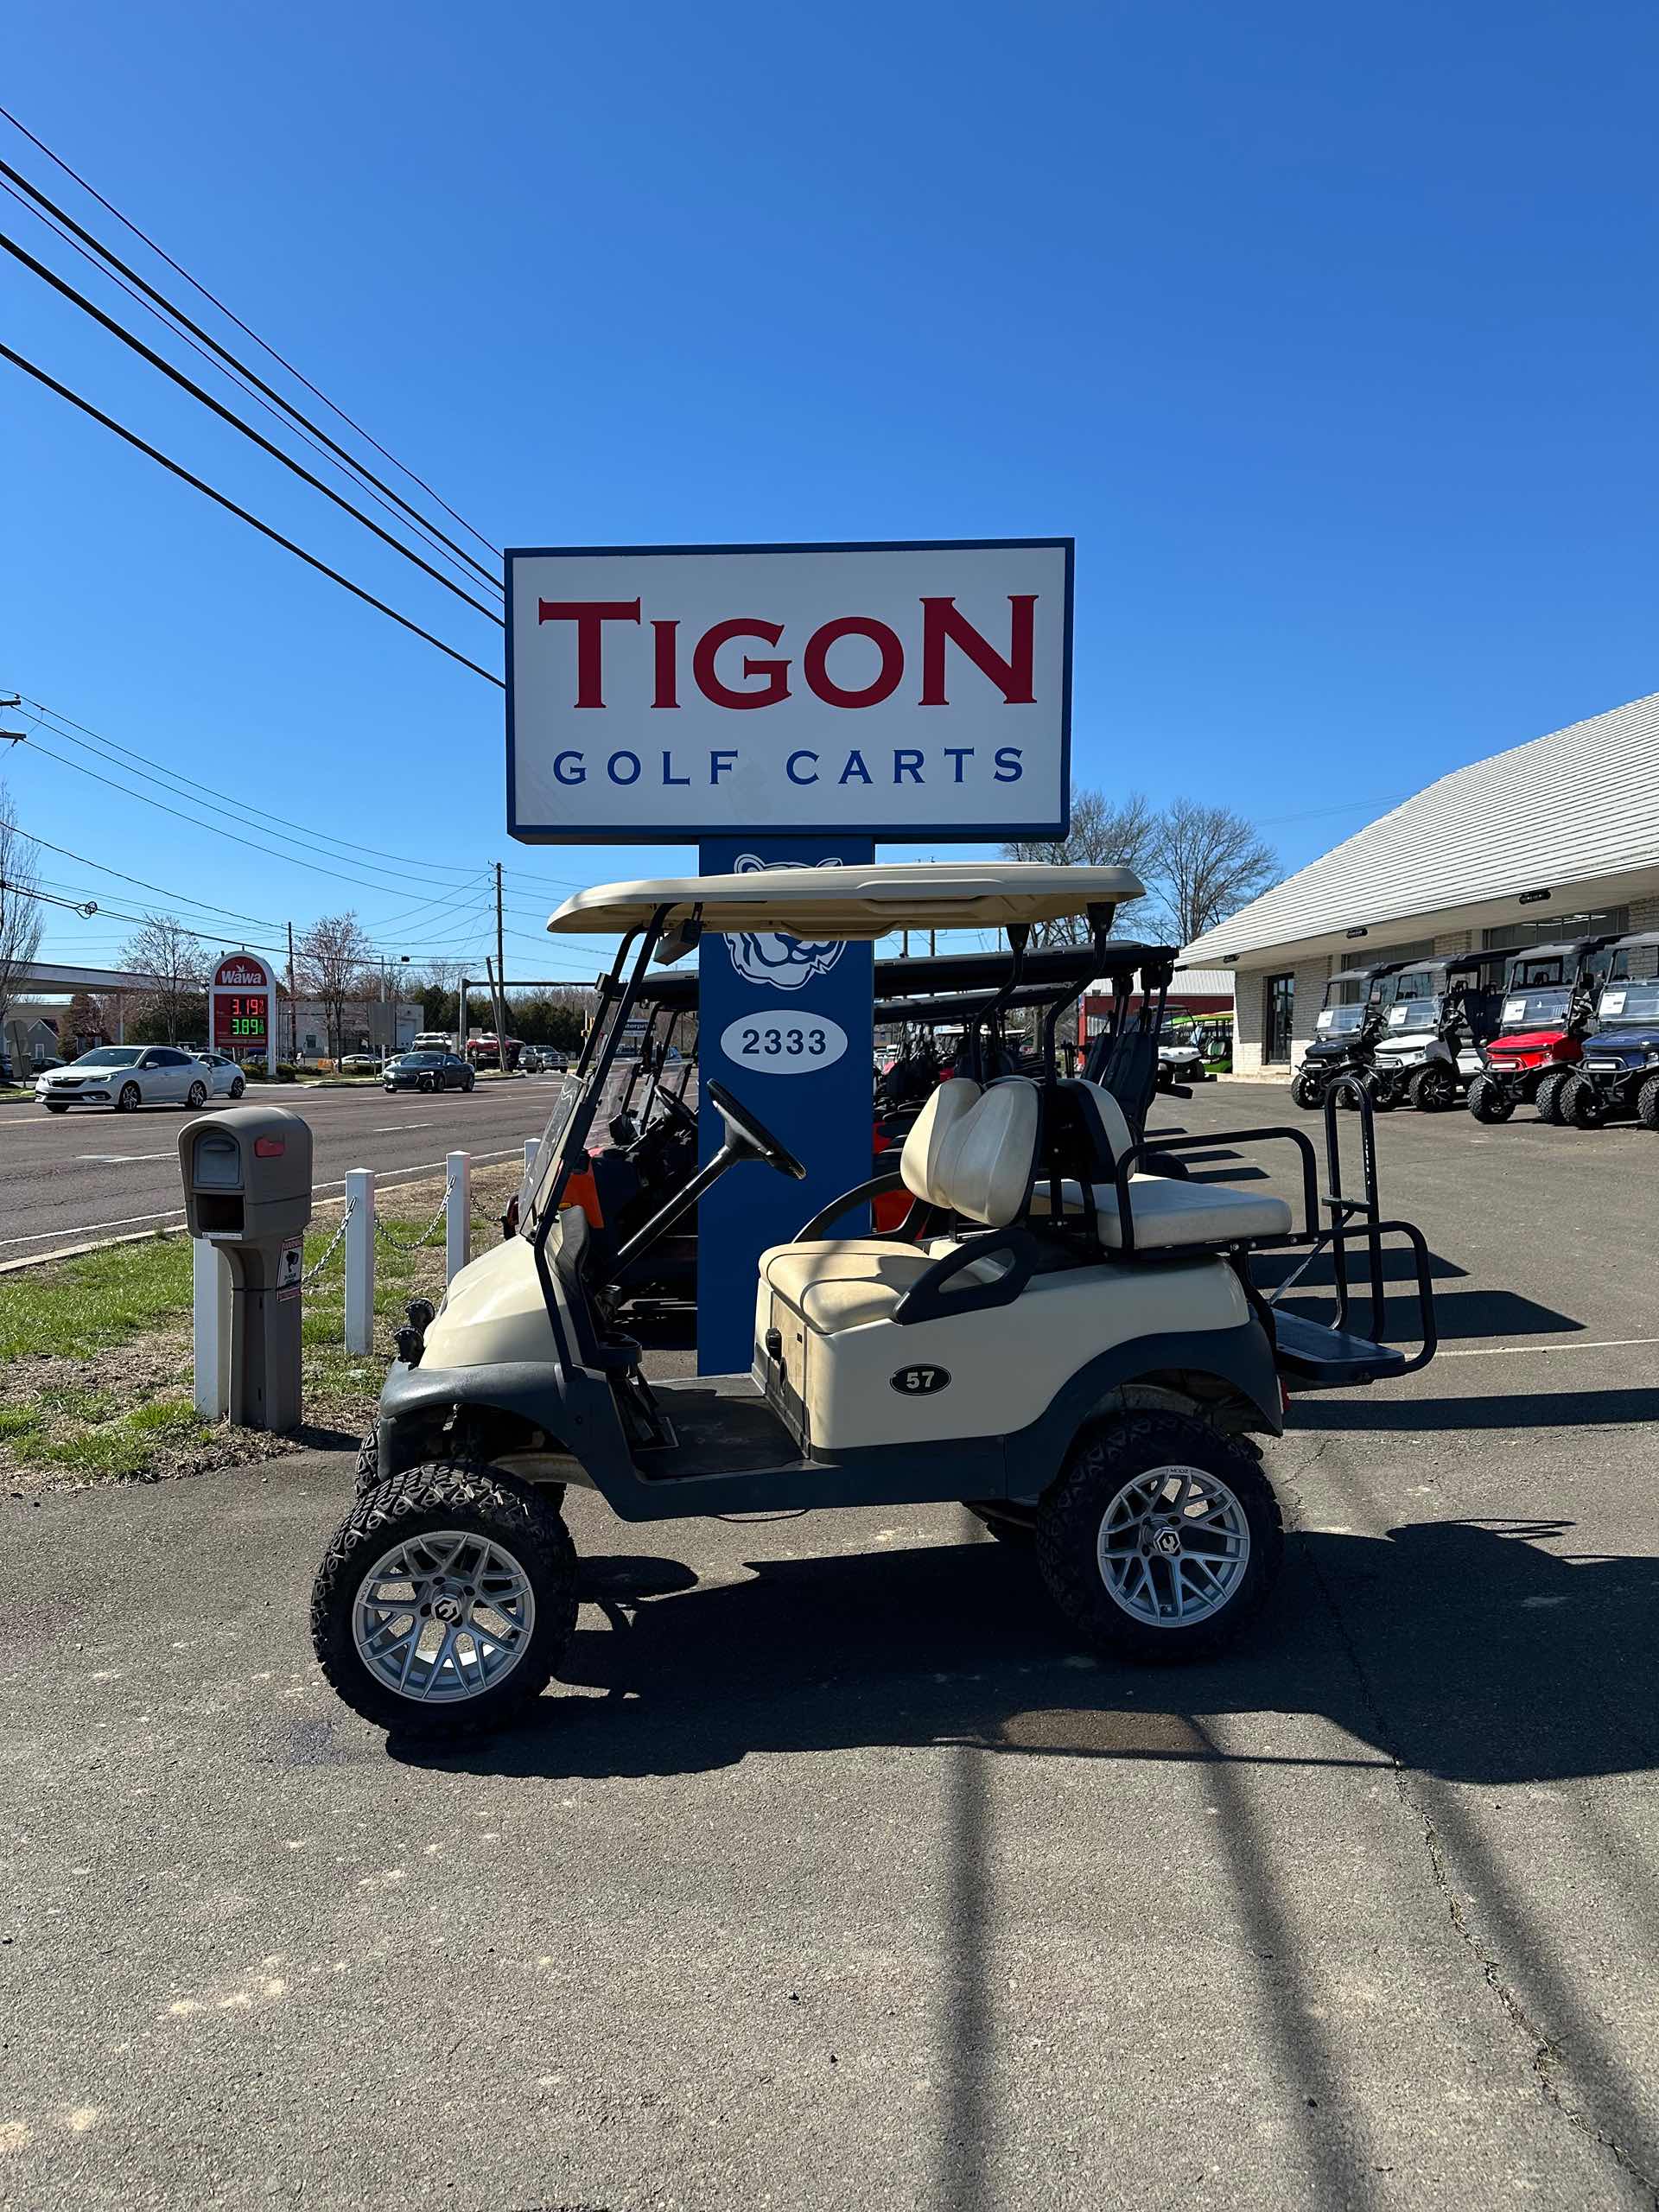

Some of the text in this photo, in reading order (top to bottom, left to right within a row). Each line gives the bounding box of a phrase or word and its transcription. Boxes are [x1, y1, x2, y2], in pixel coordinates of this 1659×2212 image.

[538, 595, 1039, 709] TIGON
[553, 747, 1024, 785] GOLF CARTS
[221, 970, 262, 984] Wawa
[741, 1029, 826, 1055] 2333
[906, 1370, 935, 1389] 57
